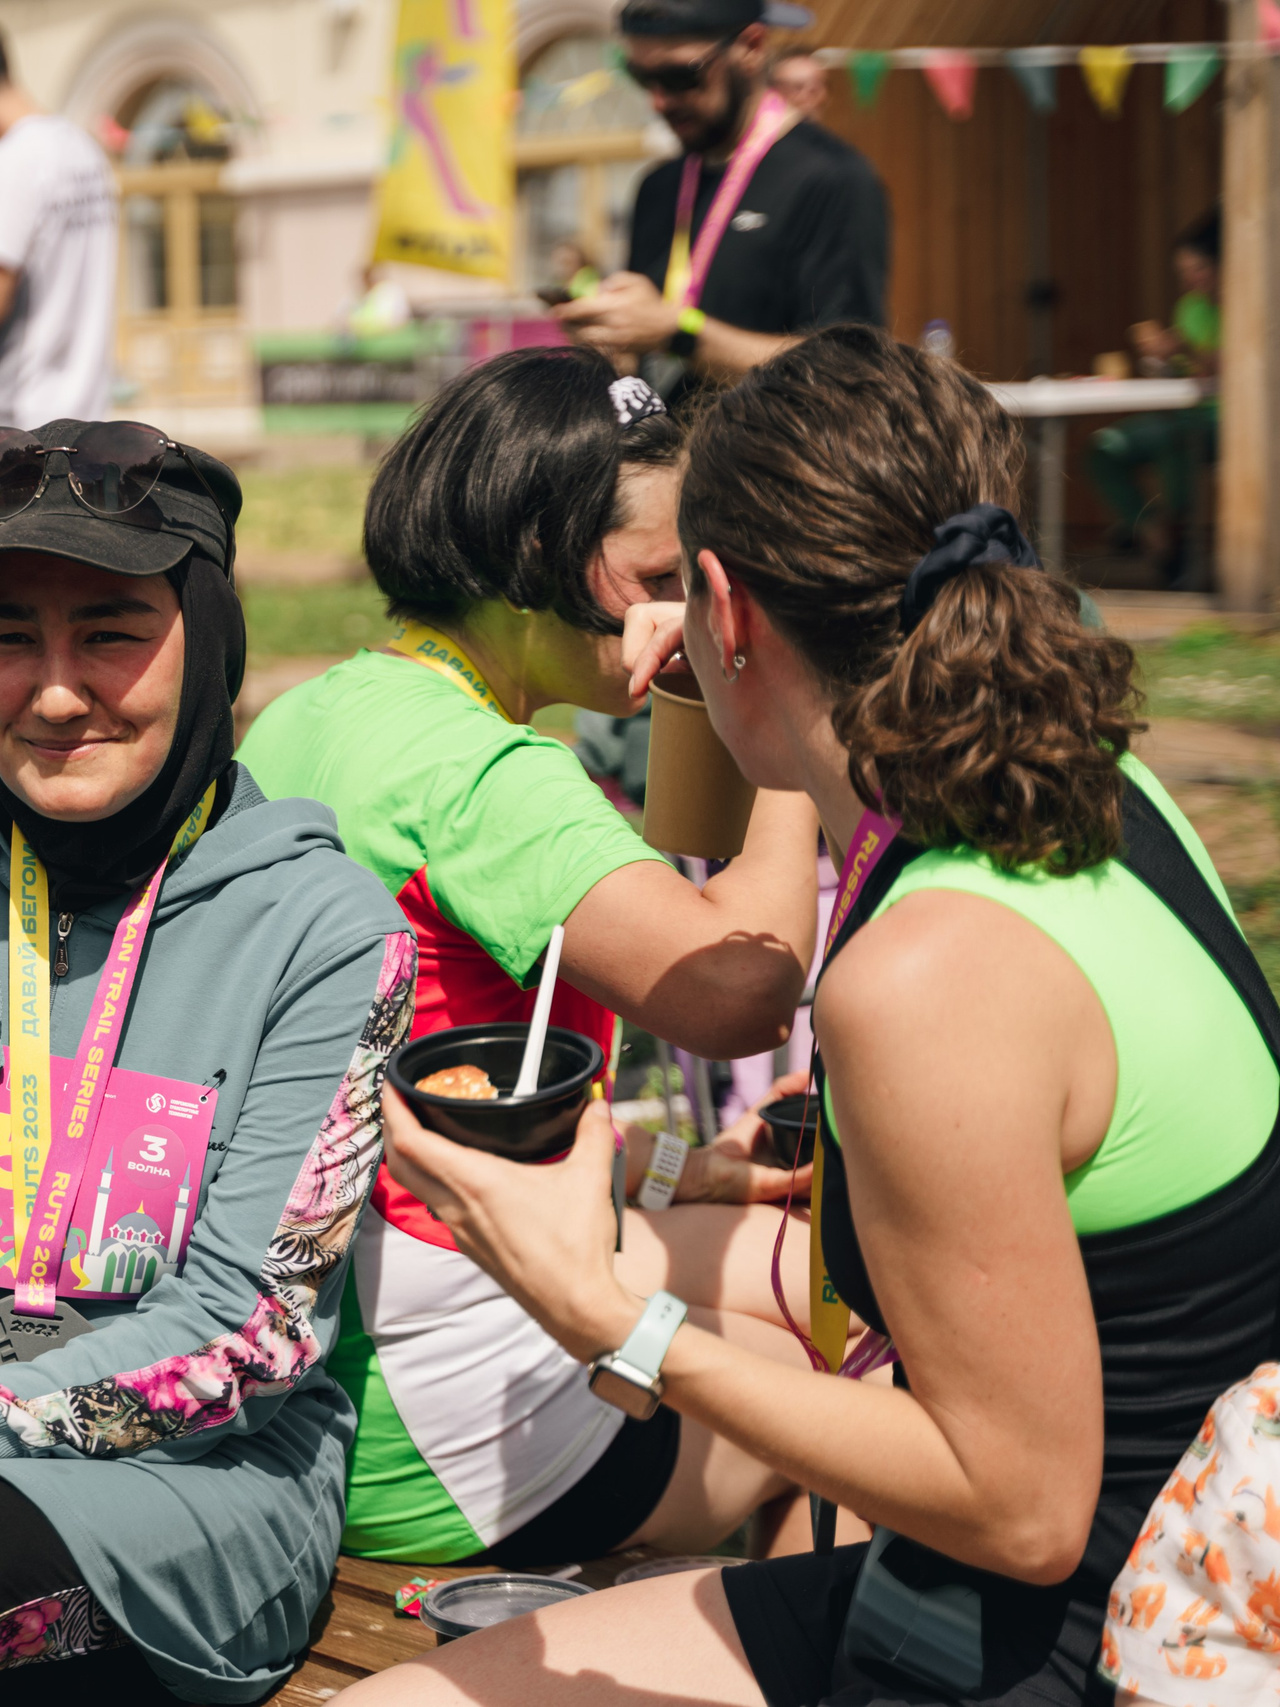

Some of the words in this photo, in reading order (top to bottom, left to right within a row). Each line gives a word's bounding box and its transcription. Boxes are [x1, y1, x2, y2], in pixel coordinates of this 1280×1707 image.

[416, 640, 489, 698] ДАВАЙ
[22, 843, 38, 935] БЕГОМ
[17, 942, 40, 1037] ДАВАЙ
[93, 967, 129, 1041] TRAIL
[22, 1074, 39, 1140] 2023
[67, 1046, 105, 1139] SERIES
[127, 1161, 171, 1178] ВОЛНА
[139, 1134, 168, 1162] 3
[39, 1171, 71, 1242] RUTS
[27, 1244, 51, 1306] 2023
[10, 1319, 60, 1338] 2023
